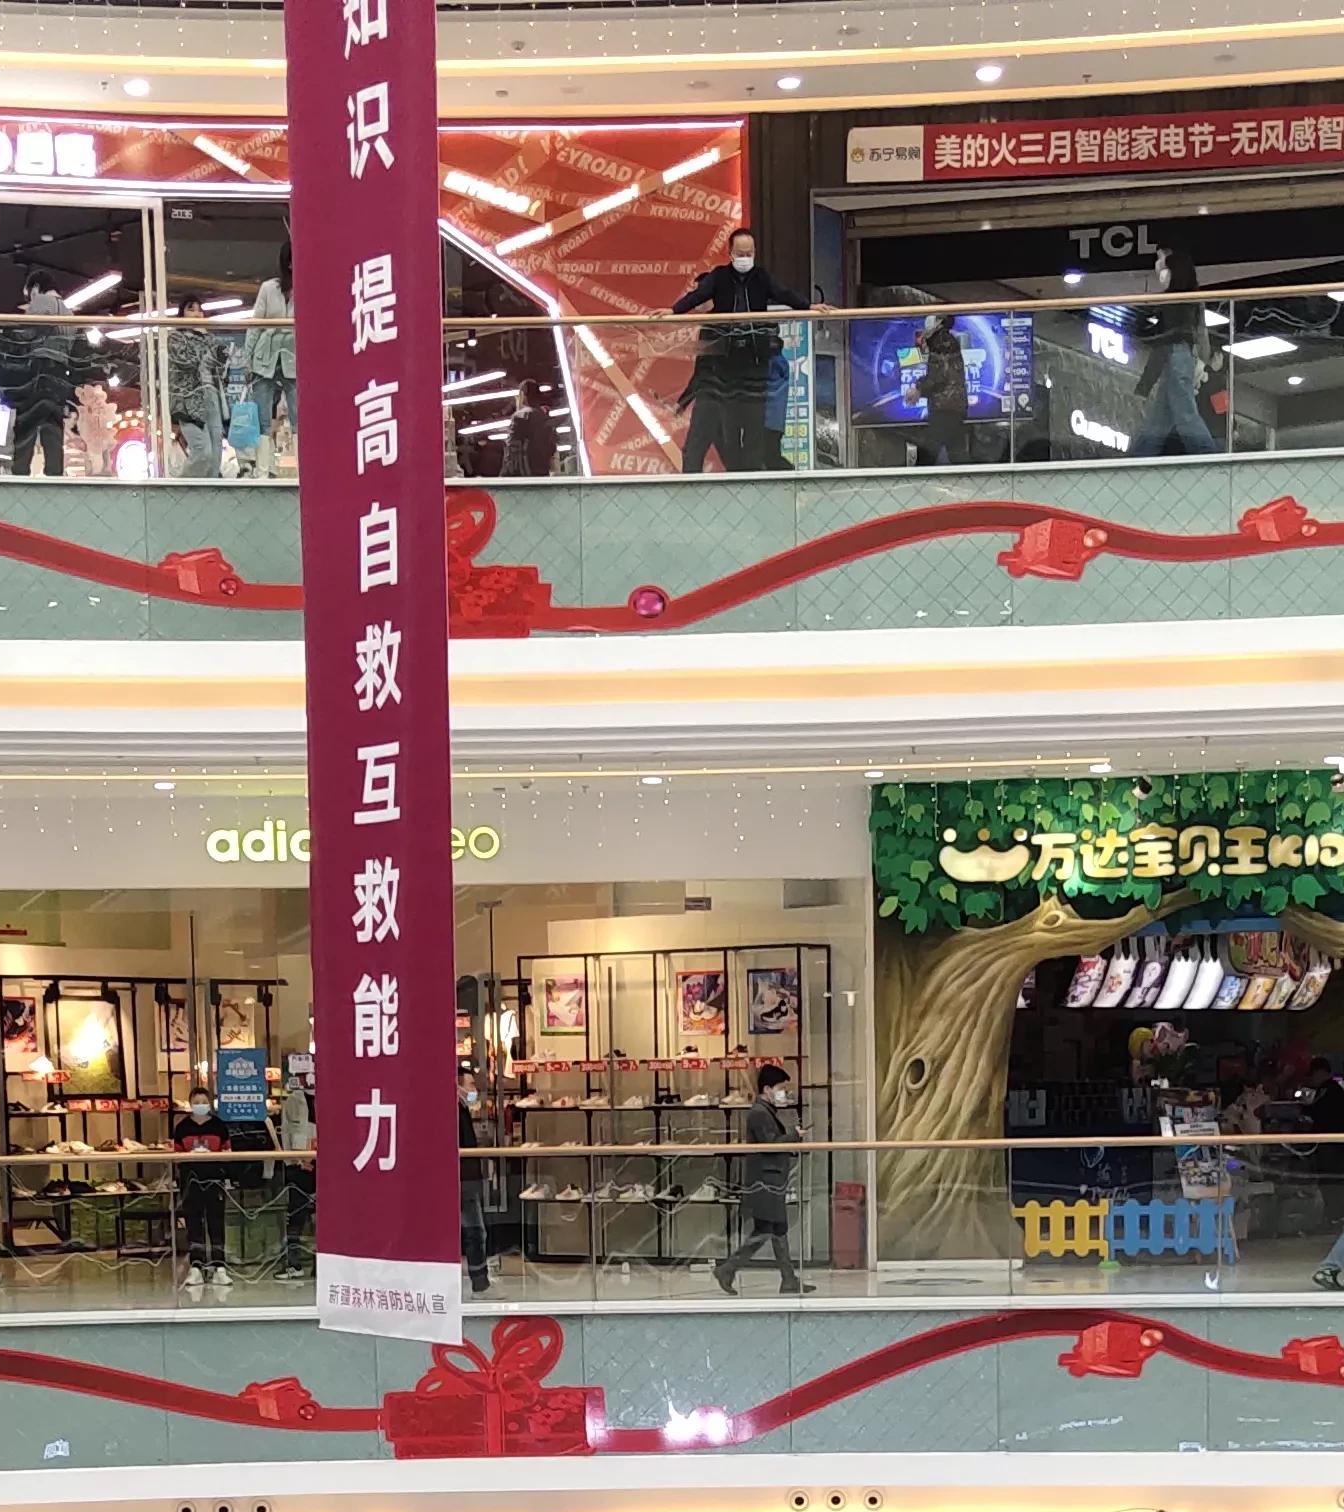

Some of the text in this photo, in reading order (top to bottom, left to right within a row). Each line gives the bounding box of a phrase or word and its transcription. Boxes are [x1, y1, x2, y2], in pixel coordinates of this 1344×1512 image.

[869, 145, 921, 162] 苏宁易购
[1069, 224, 1158, 259] TCL
[1088, 322, 1129, 365] TCL
[351, 254, 401, 1173] 提高自救互救能力
[206, 820, 500, 863] adi eo
[1030, 822, 1268, 880] 万达宝贝王
[328, 1284, 447, 1315] 新疆森林消防总队宣
